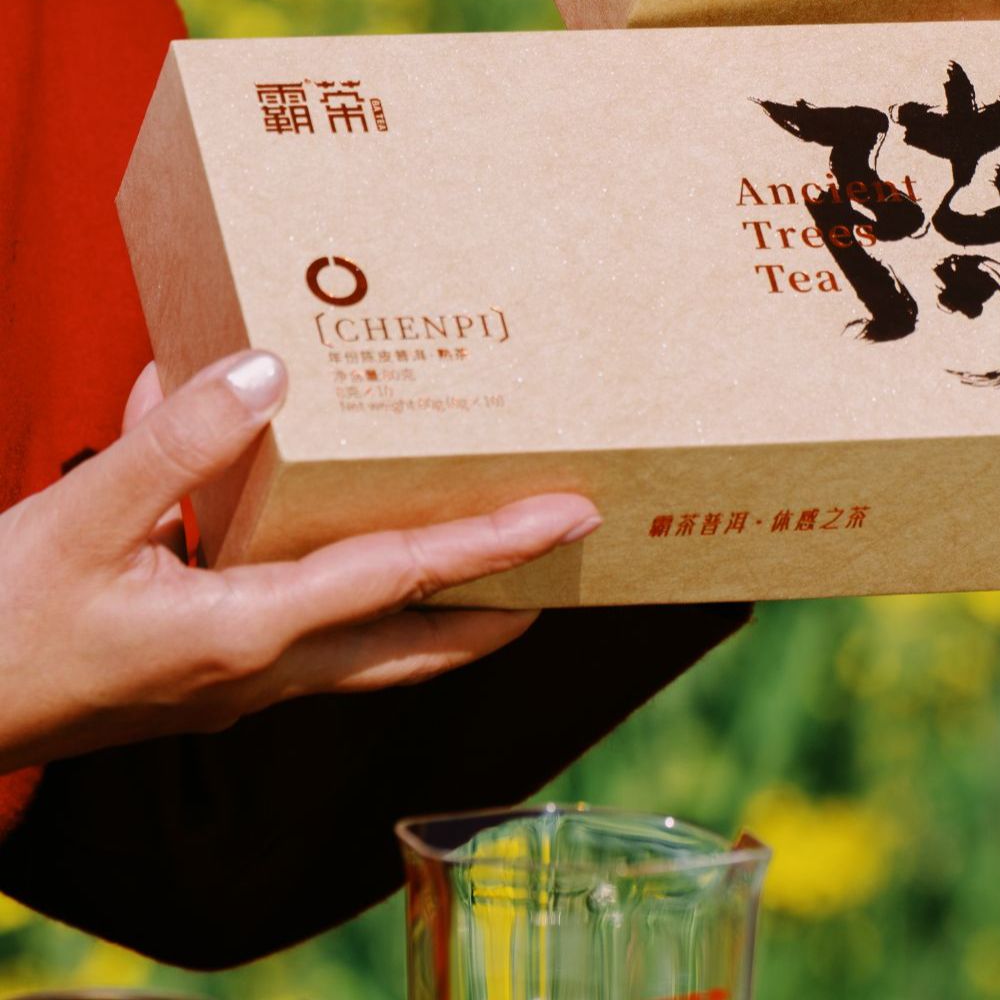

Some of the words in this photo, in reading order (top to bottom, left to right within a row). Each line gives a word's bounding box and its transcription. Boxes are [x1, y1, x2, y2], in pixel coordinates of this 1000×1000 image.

[736, 173, 922, 207] Ancient
[742, 221, 878, 250] Trees
[755, 264, 842, 294] Tea
